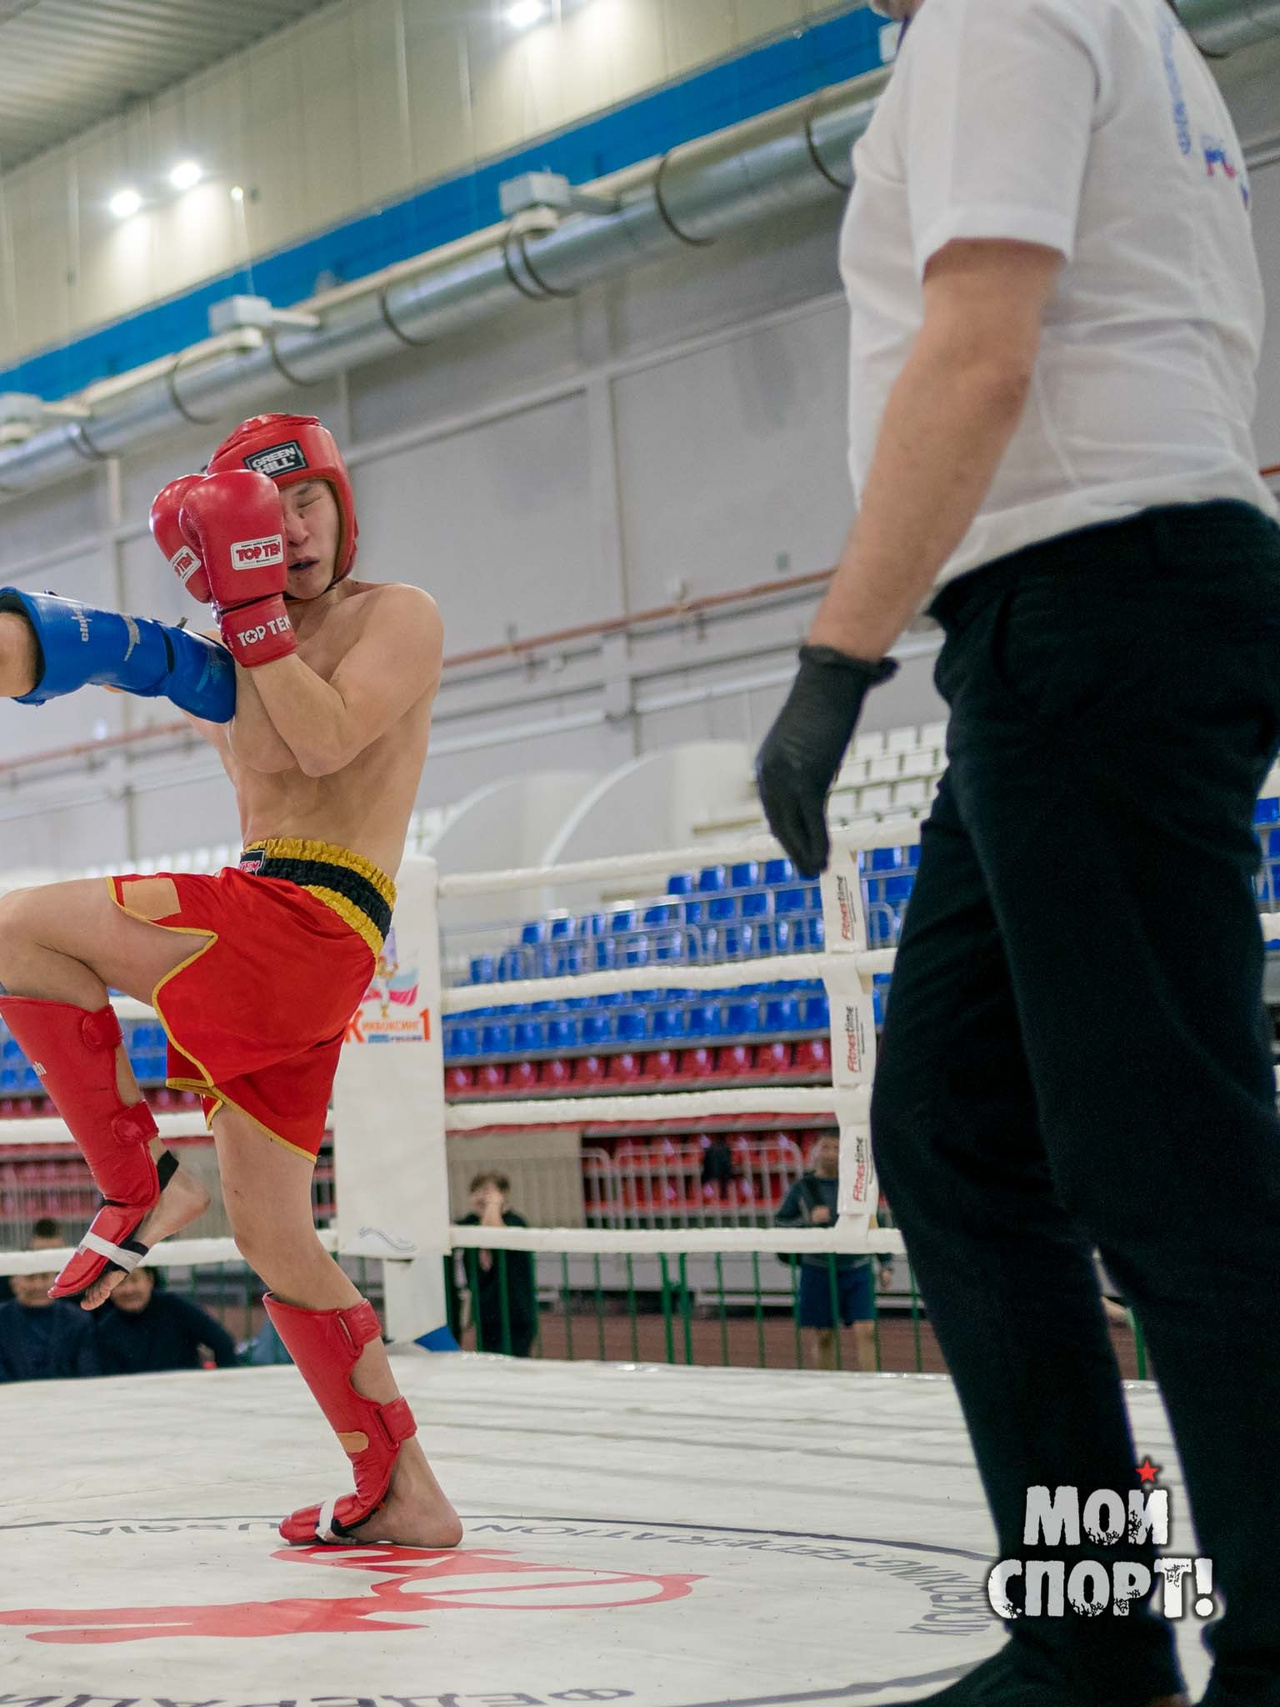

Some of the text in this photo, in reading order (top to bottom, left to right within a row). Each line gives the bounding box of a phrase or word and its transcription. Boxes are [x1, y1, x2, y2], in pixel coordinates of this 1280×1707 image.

[252, 447, 296, 468] GREEN
[235, 546, 262, 561] TOP
[236, 625, 266, 647] TOP
[470, 1524, 883, 1561] FEDERATION
[853, 1559, 996, 1637] KICKBOXING
